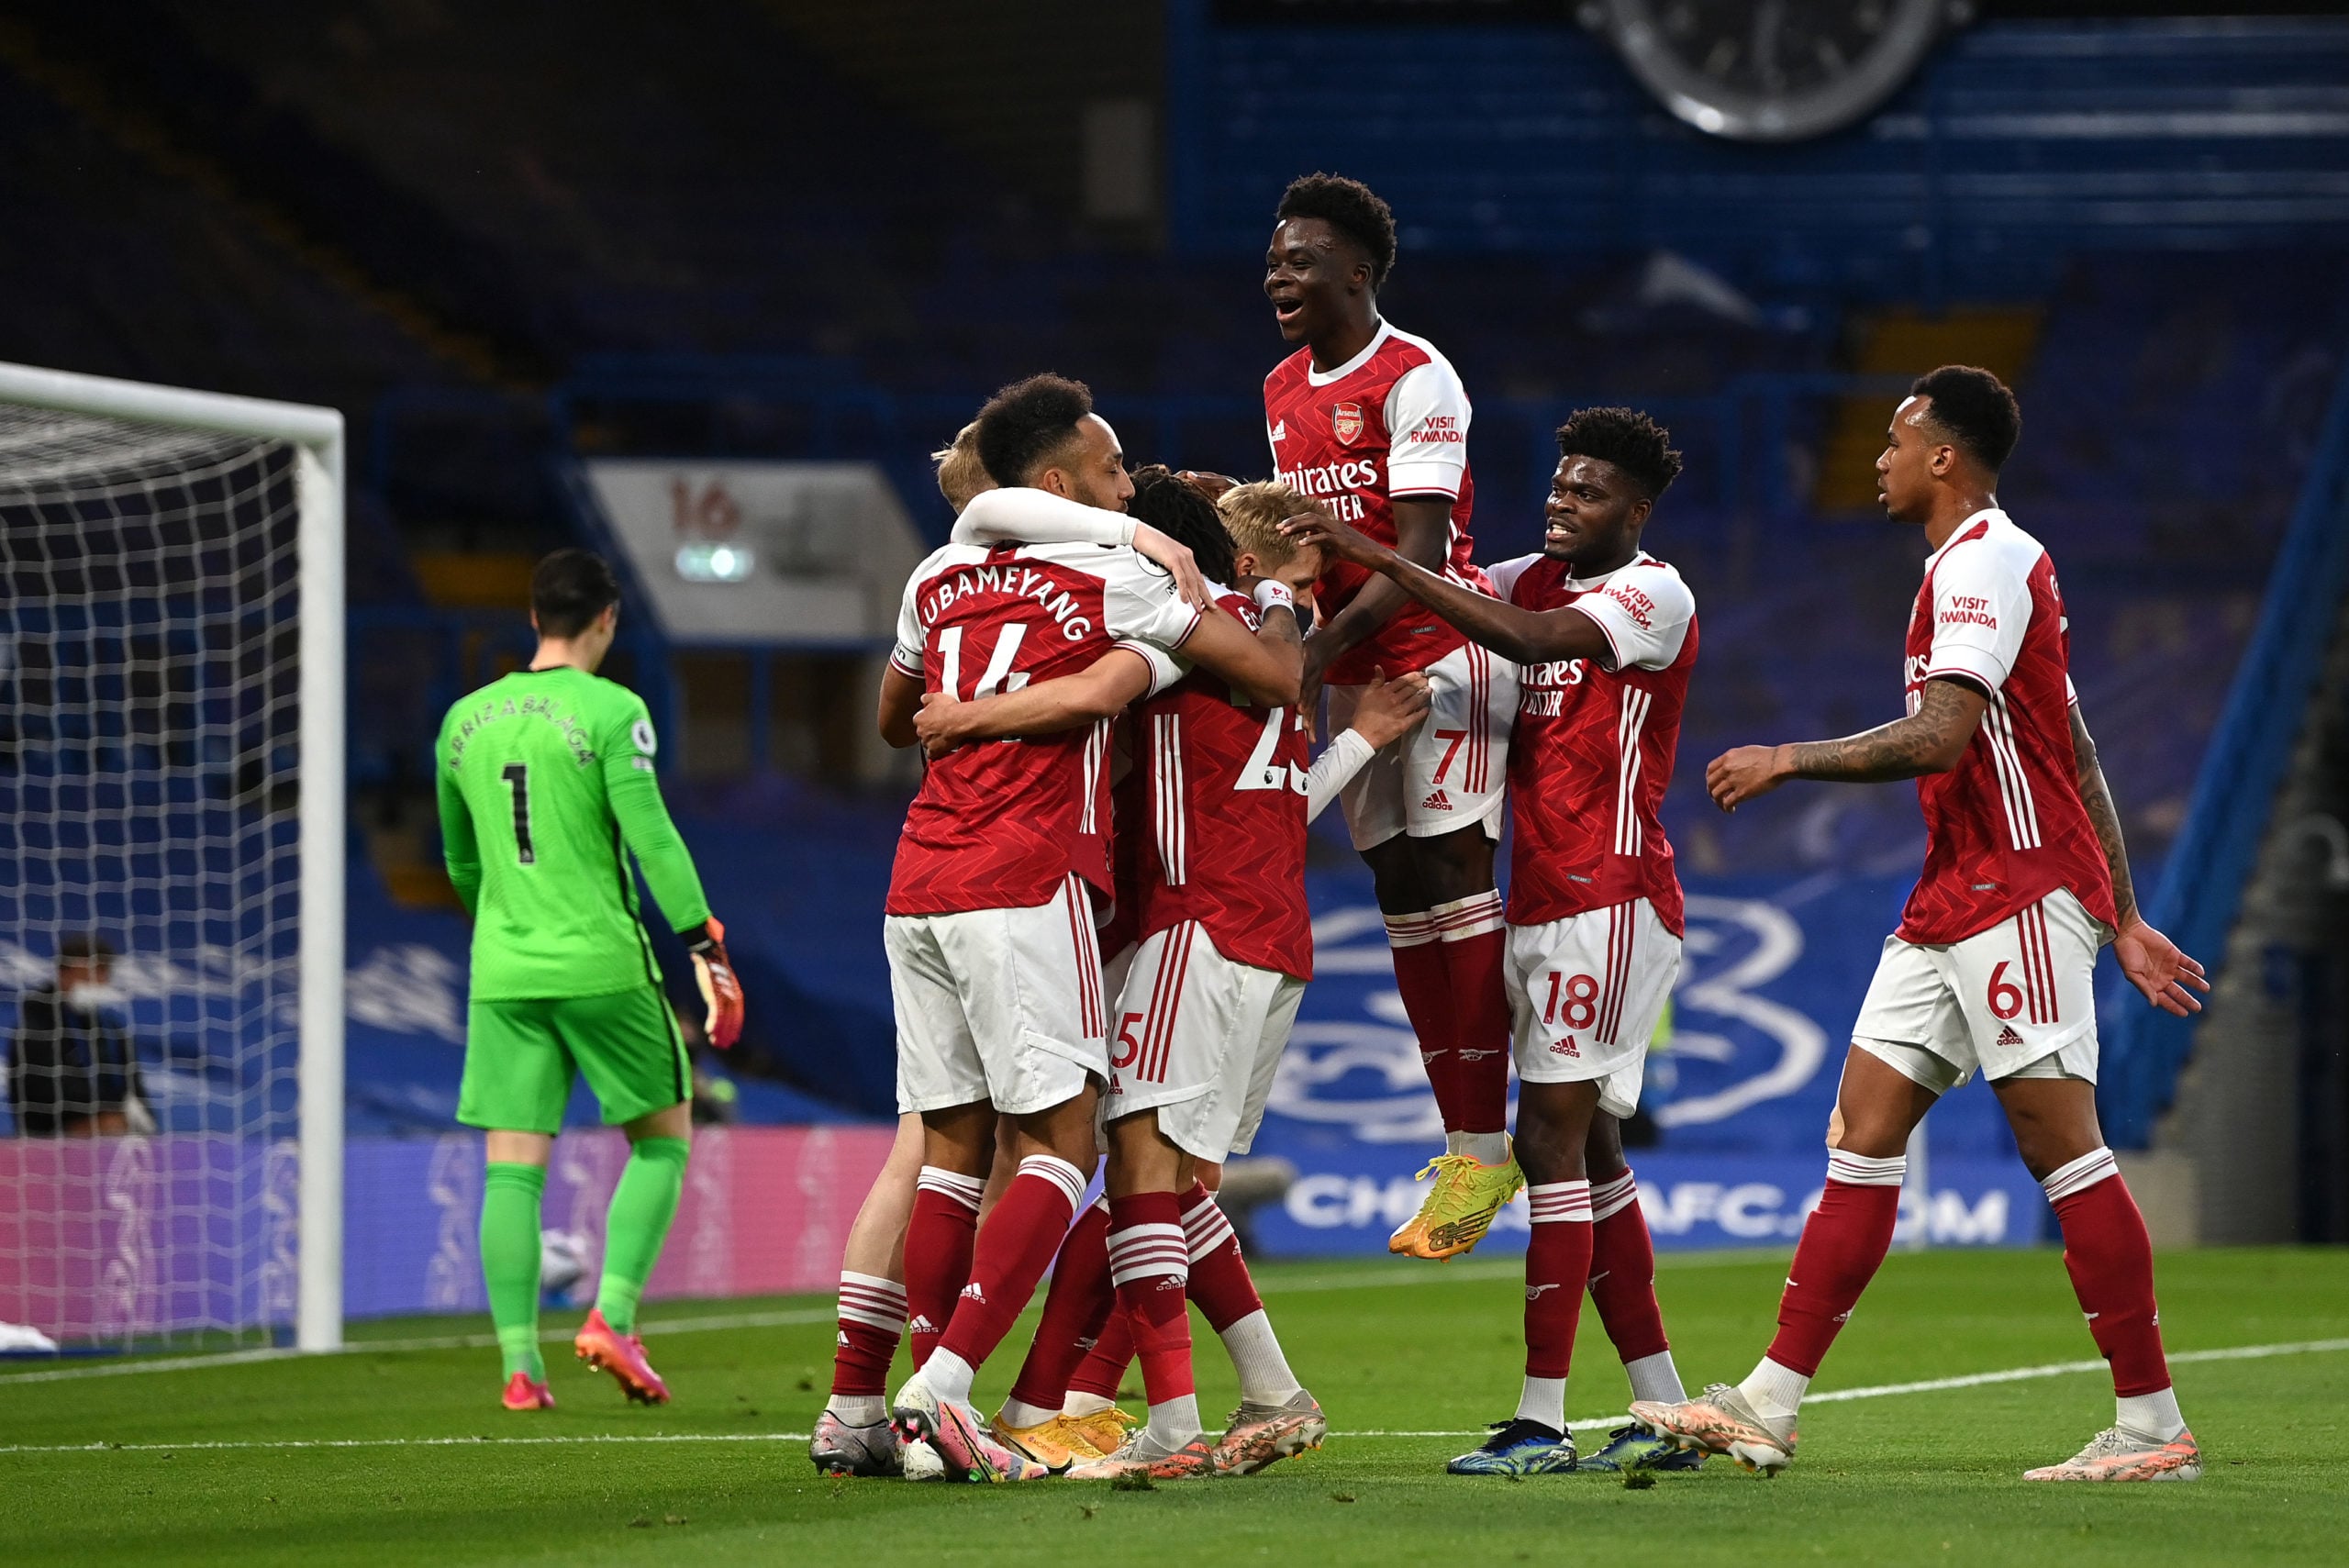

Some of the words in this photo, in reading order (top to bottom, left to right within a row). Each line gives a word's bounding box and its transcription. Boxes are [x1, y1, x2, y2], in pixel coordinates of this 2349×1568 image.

[1410, 429, 1464, 443] RWANDA
[1425, 416, 1455, 428] VISIT
[1280, 460, 1378, 495] mirates
[669, 477, 742, 541] 16
[1625, 584, 1655, 613] VISIT
[1952, 596, 1988, 610] VISIT
[1940, 611, 1997, 630] RWANDA
[1432, 728, 1469, 785] 7
[501, 763, 535, 865] 1
[1421, 801, 1453, 811] adidas
[1542, 971, 1599, 1030] 18
[1987, 961, 2024, 1020] 6
[1110, 1012, 1144, 1069] 5
[1549, 1043, 1581, 1058] adidas
[1996, 1036, 2024, 1047] adidas
